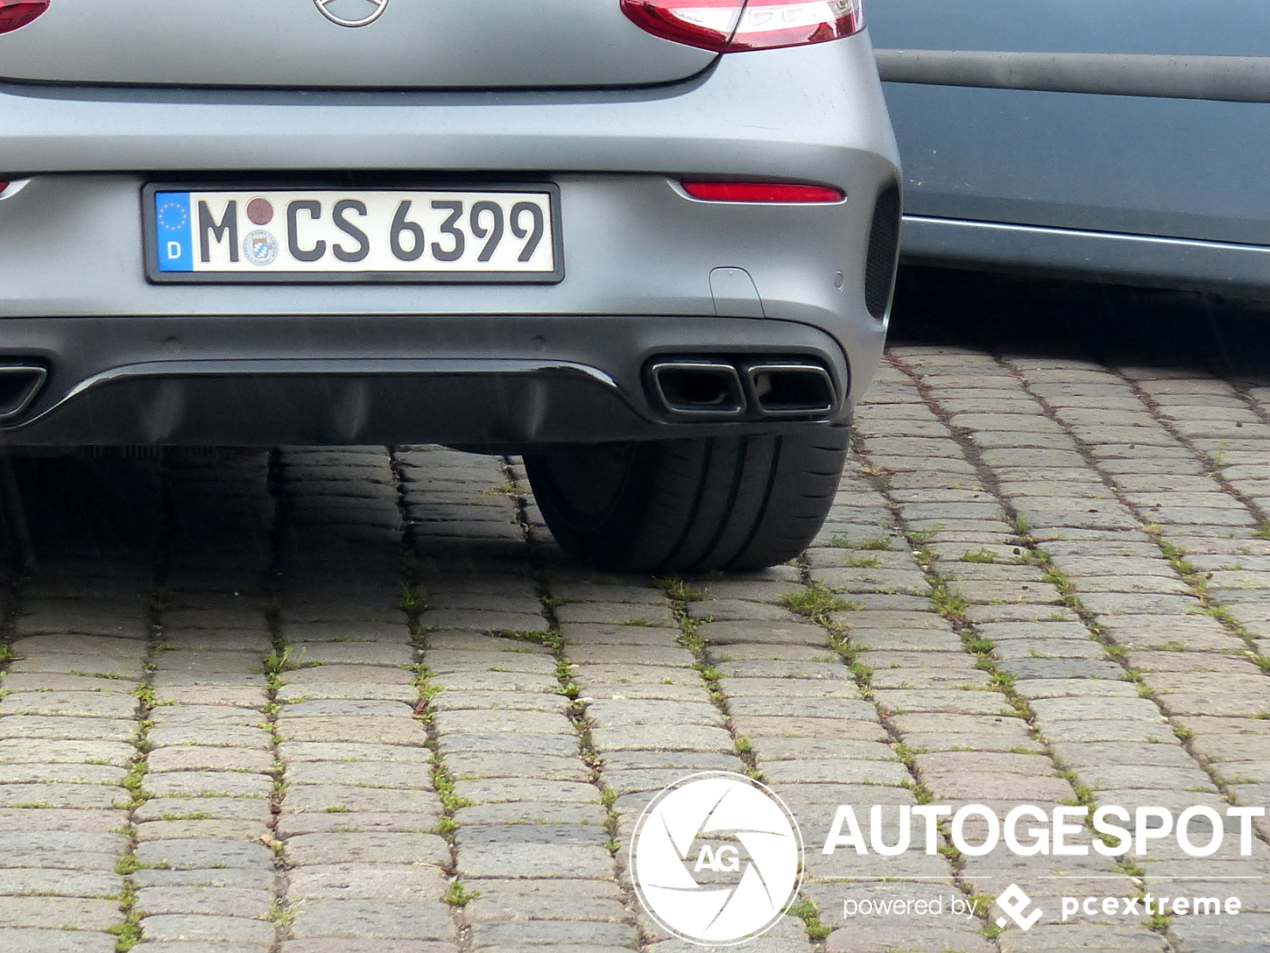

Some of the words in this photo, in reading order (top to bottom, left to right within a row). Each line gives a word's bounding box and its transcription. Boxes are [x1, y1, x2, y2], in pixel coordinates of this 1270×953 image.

[167, 241, 182, 260] D
[198, 200, 239, 262] M
[286, 199, 370, 262] CS
[390, 200, 544, 262] 6399
